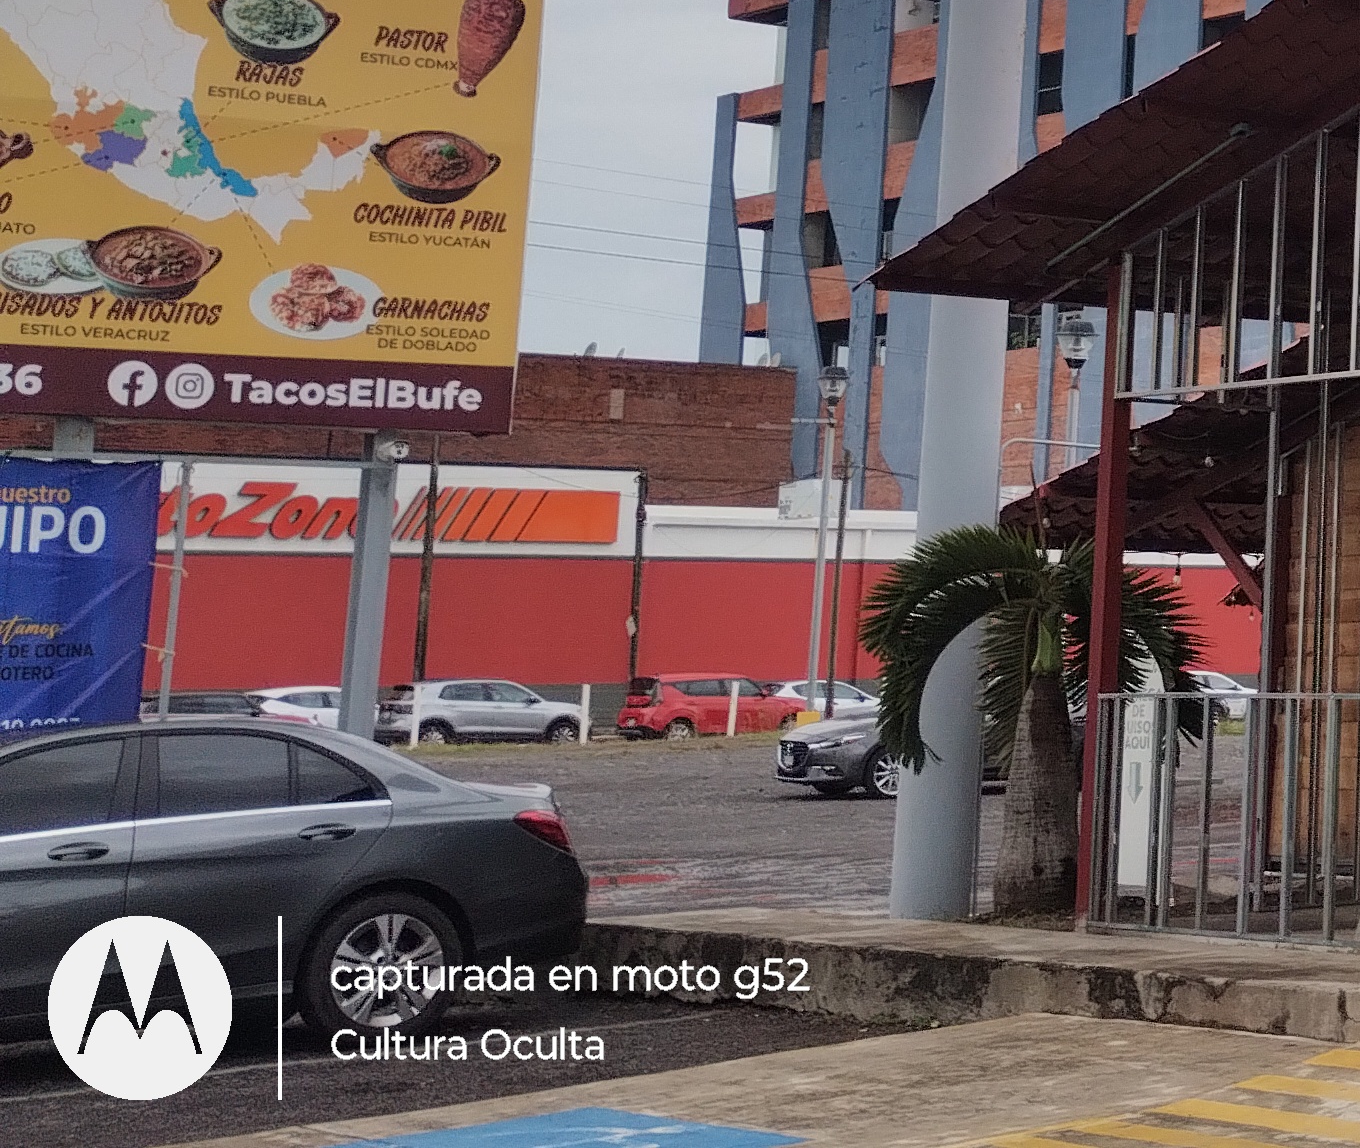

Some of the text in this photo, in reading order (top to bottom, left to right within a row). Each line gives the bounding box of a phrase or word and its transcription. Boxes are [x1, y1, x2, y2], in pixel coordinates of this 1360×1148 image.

[373, 25, 449, 53] PASTOR
[360, 52, 458, 71] ESTILO CDMX
[235, 59, 306, 88] RAJAS
[208, 85, 327, 108] ESTILO PUEBLA
[353, 202, 508, 233] COCHINITA PIBIL
[0, 221, 36, 235] ATO
[368, 231, 491, 249] ESTILO YUCATÁN
[0, 290, 223, 326] ISADOS Y ANTOJITOS
[372, 296, 491, 323] GARNACHAS
[20, 322, 171, 343] ESTILO VERACRUZ
[365, 323, 491, 341] ESTILO SOLEDAD
[377, 337, 477, 353] DE DOBLADO
[223, 373, 483, 412] TacosElBufe
[0, 485, 71, 504] uestro
[35, 643, 94, 658] COCINA
[0, 665, 55, 681] OTERO
